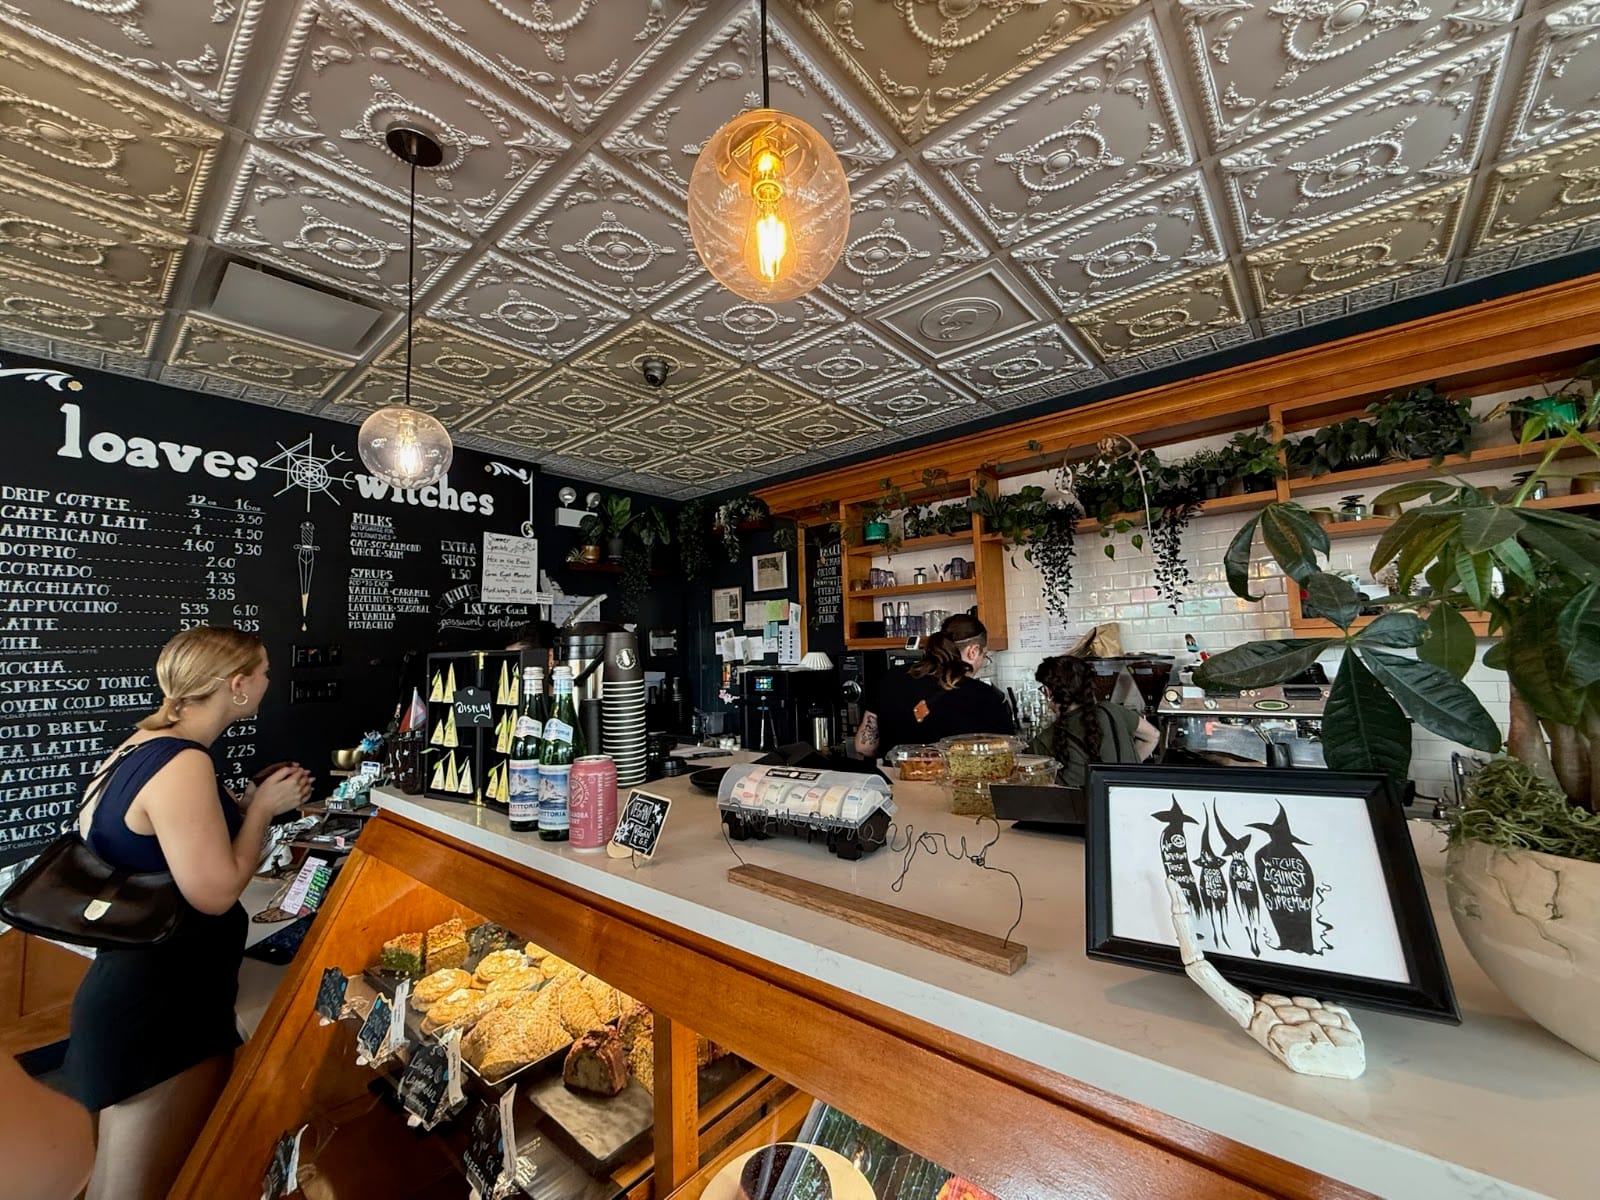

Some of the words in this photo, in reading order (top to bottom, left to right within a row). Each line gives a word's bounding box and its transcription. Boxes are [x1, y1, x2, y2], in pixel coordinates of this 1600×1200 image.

[57, 403, 259, 481] loaves
[355, 472, 494, 517] witches
[2, 486, 50, 503] DRIP
[55, 492, 130, 512] COFFEE
[191, 508, 201, 519] 3
[235, 513, 263, 526] 3.50
[0, 505, 59, 522] CAFE
[63, 511, 96, 525] AU
[101, 514, 148, 530] LAIT
[352, 512, 393, 528] MILKS
[0, 523, 119, 545] AMERICANO
[183, 538, 216, 553] 4.60
[234, 542, 263, 556] 5.30
[440, 540, 477, 555] EXTRA
[0, 542, 78, 560] DOPPIO
[206, 556, 236, 569] 2.60
[441, 553, 476, 567] SHOTS
[0, 561, 94, 578] CORTADO
[205, 571, 236, 585] 4.35
[350, 567, 394, 580] SYRUPS
[0, 580, 112, 597] MACCHIATO
[206, 587, 236, 601] 3.85
[180, 602, 210, 615] 5.35
[233, 604, 259, 616] 6.10
[348, 621, 394, 630] PISTACHIO
[96, 676, 151, 690] TONIC
[63, 696, 106, 710] COLD
[109, 692, 154, 707] BREW
[455, 701, 492, 723] DISPLAY
[47, 720, 108, 736] BREW
[226, 725, 257, 738] 6.25
[31, 737, 104, 756] LATTE
[226, 743, 257, 759] 7.25
[232, 761, 243, 774] 3
[1261, 857, 1305, 873] WITCHES
[1263, 868, 1306, 888] AGAINST
[1270, 884, 1301, 896] WHITE
